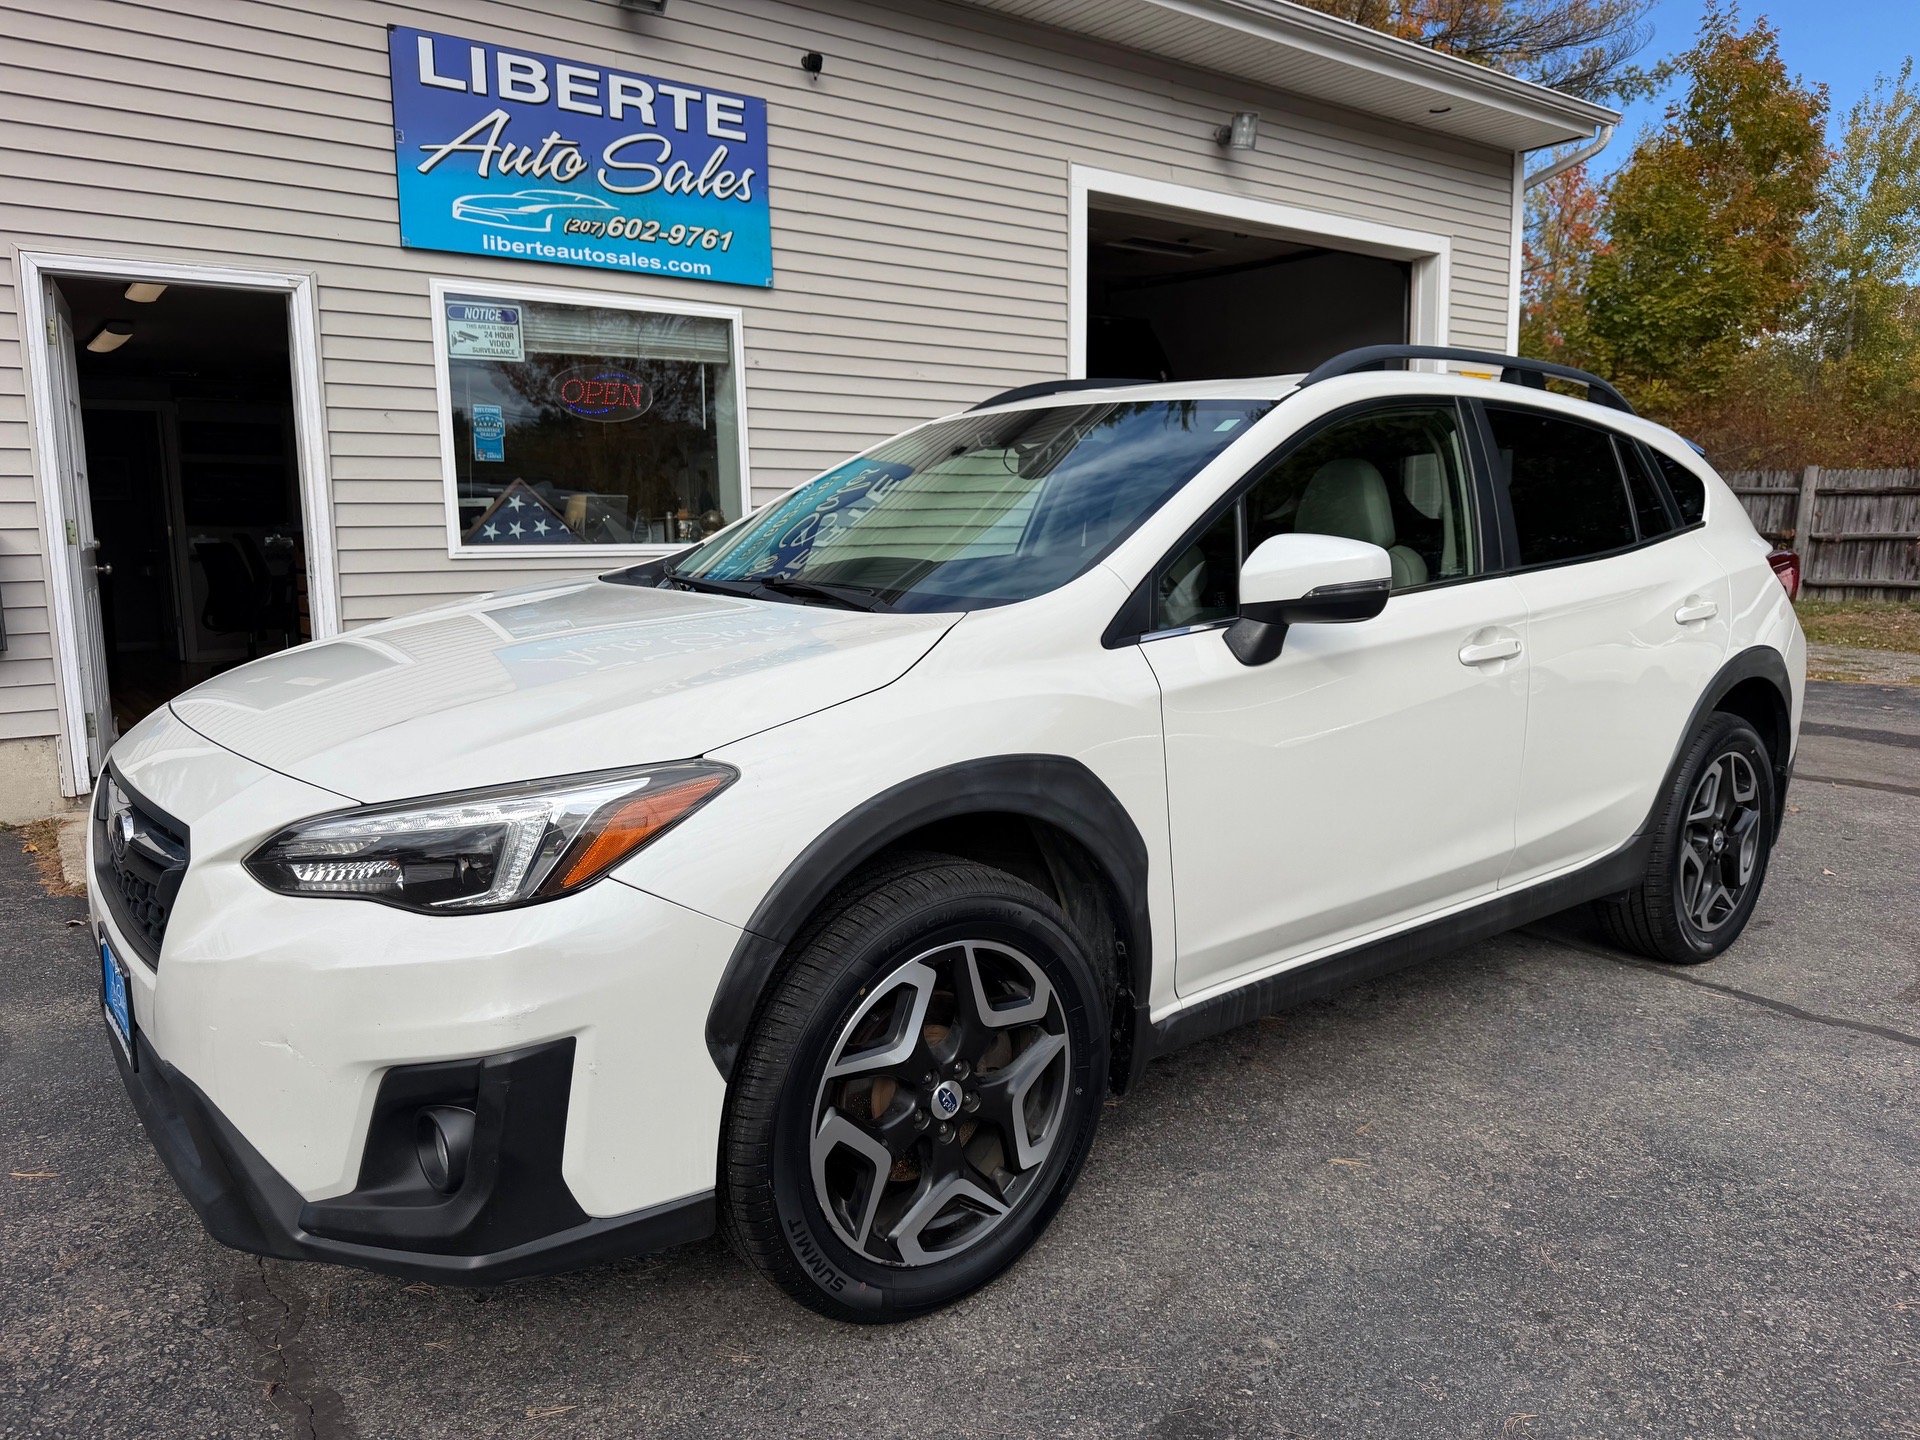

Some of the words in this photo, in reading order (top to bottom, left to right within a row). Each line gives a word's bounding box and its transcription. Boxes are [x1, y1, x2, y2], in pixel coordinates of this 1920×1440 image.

[417, 36, 747, 142] LIBERTE
[417, 108, 588, 182] Auto
[597, 132, 755, 201] Sales
[563, 216, 734, 252] (207)602-9761
[482, 233, 712, 276] liberteautosales.com
[464, 306, 502, 321] NOTICE
[472, 346, 516, 355] SURVEILLANCE
[489, 339, 511, 348] VIDEO
[494, 332, 515, 340] HOUR
[561, 379, 643, 407] OPEN
[787, 1219, 847, 1293] SUMMIT
